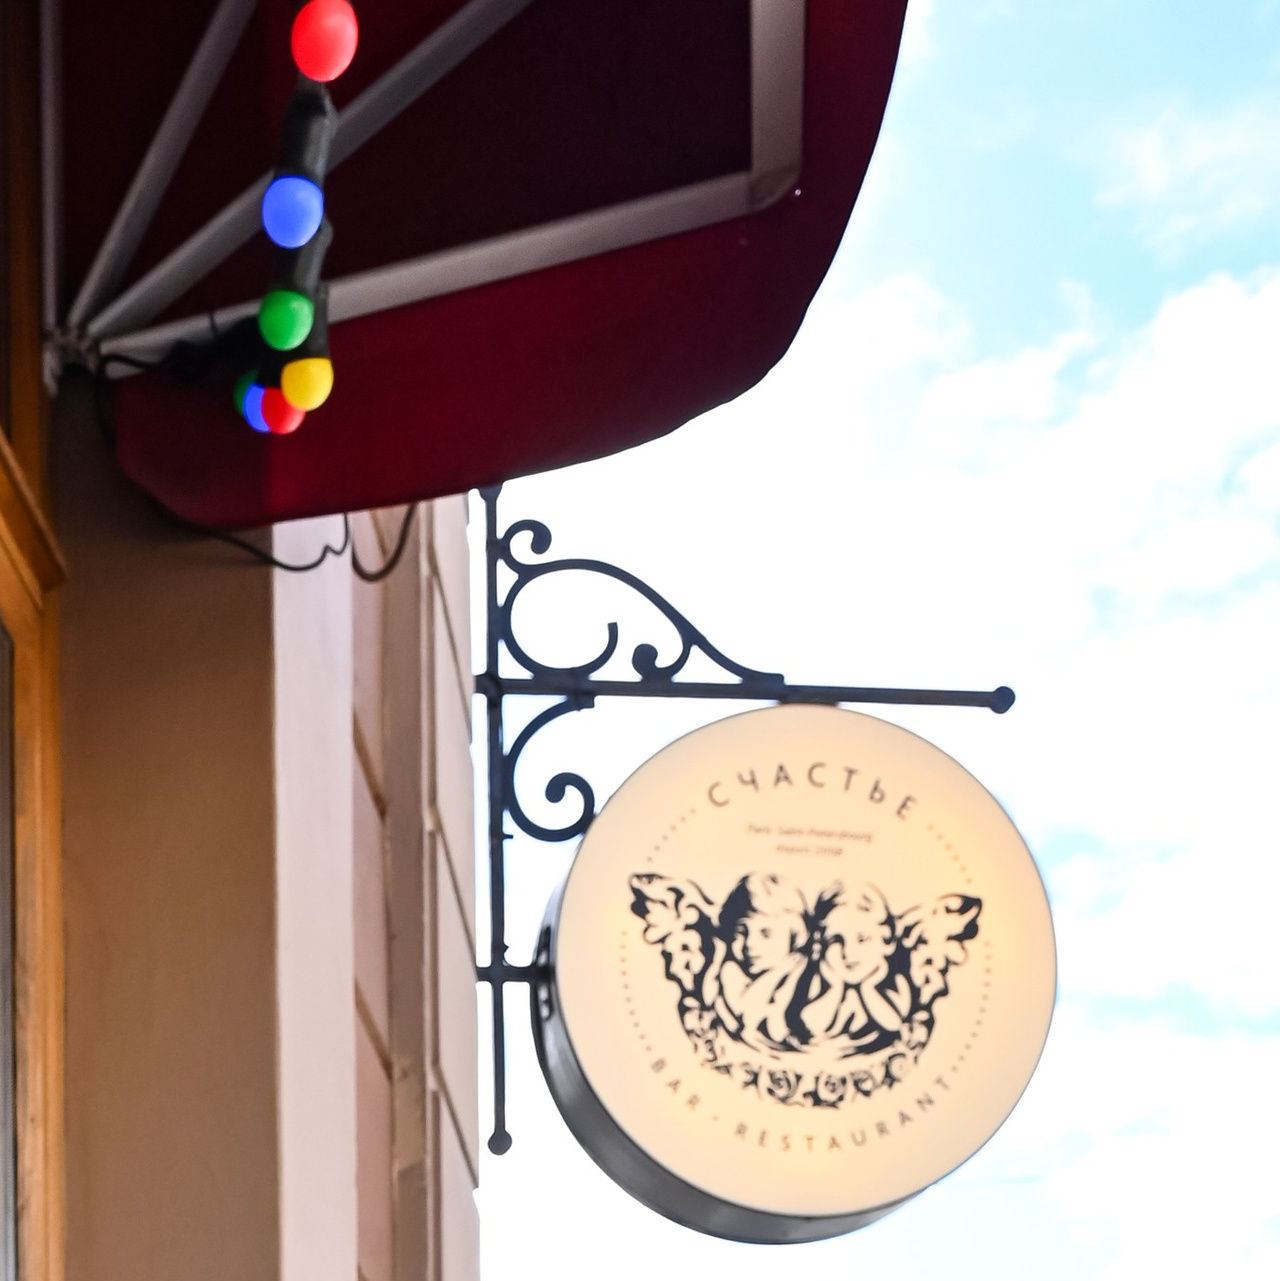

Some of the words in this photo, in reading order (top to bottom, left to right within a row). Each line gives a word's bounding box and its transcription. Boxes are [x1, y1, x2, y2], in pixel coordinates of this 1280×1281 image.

[707, 762, 919, 821] СЧАСТЬЕ
[650, 1057, 700, 1111] BAR
[734, 1076, 953, 1151] RESTAURANT
